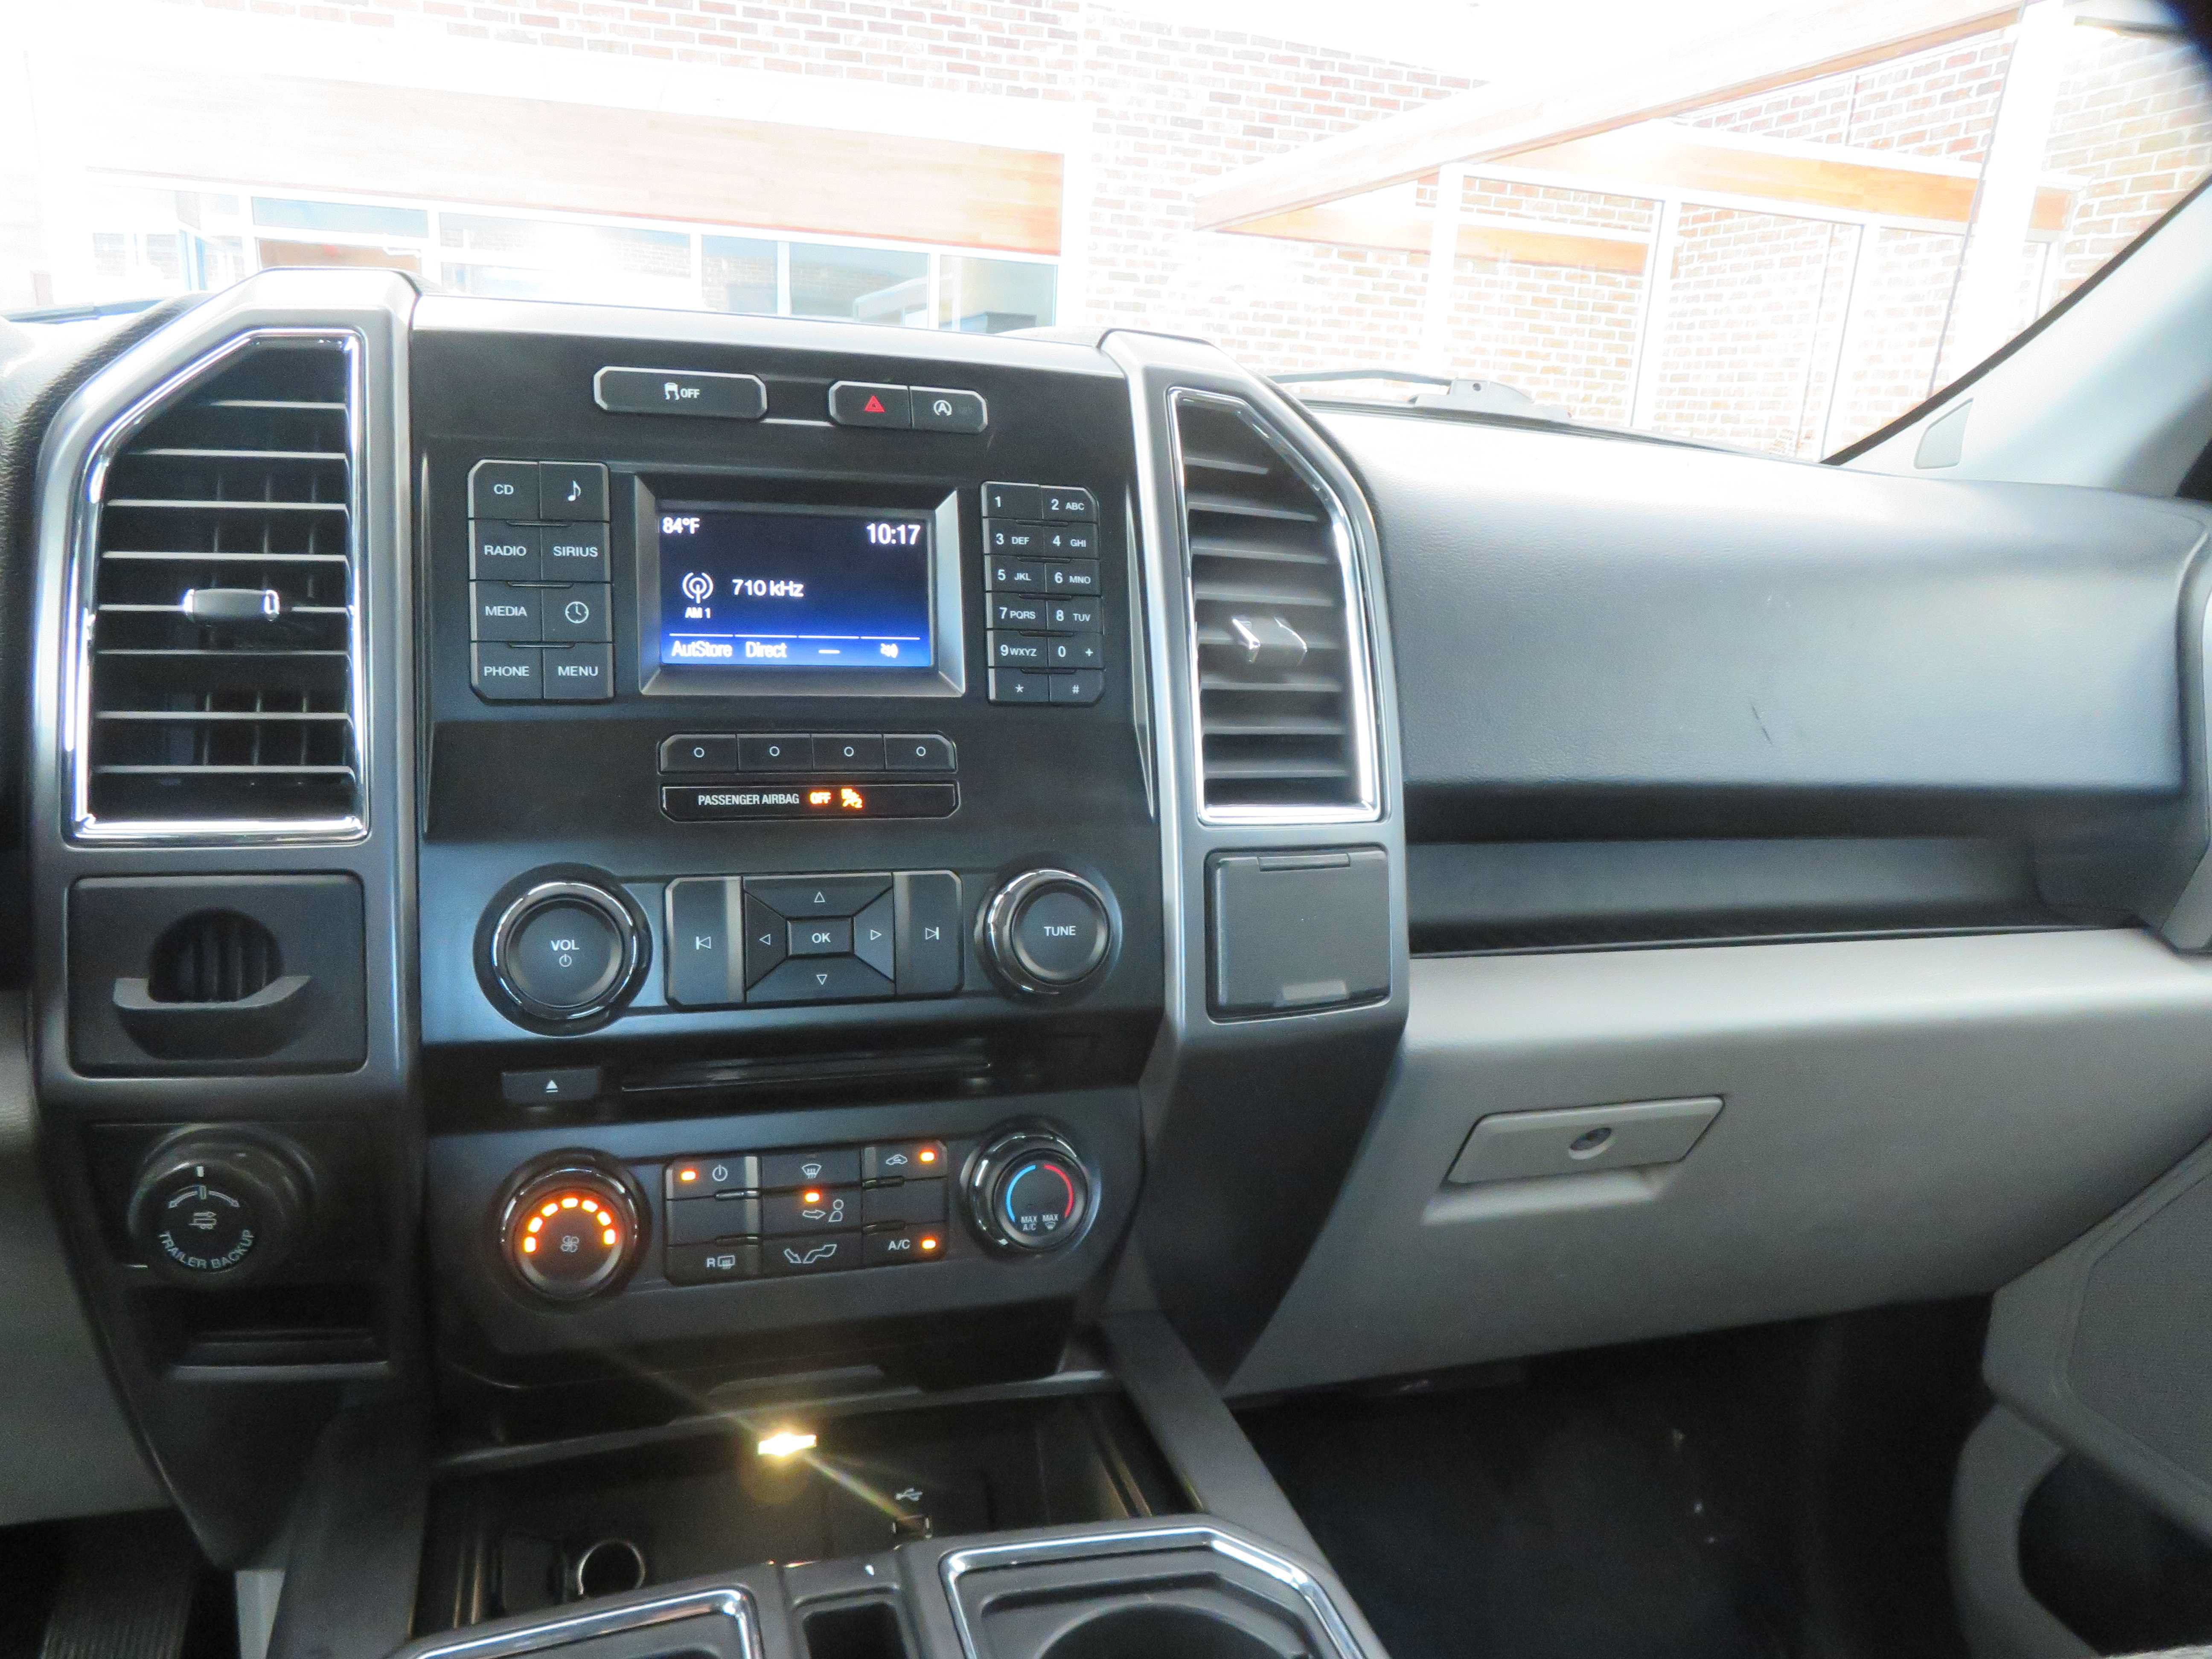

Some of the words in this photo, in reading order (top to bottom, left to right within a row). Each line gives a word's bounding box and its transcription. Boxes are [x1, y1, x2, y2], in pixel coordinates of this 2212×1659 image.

[680, 388, 700, 398] OFF
[494, 484, 514, 495] CD
[995, 496, 1001, 507] 1
[1051, 498, 1059, 510] 2
[1065, 502, 1084, 510] ABC
[867, 523, 921, 545] 10:17
[996, 533, 1004, 545] 3
[1012, 536, 1029, 545] DEF
[1053, 535, 1061, 546] 4
[1070, 539, 1086, 547] GHI
[484, 545, 527, 556] RADIO
[553, 546, 598, 557] SIRIUS
[998, 569, 1006, 581] 5
[1014, 573, 1031, 581] JKL
[1055, 572, 1063, 583] 6
[1069, 576, 1091, 584] MNO
[732, 579, 767, 596] 710
[769, 580, 804, 597] kHz
[485, 606, 527, 616] MEDIA
[685, 607, 702, 618] AM
[704, 608, 710, 618] 1
[1056, 610, 1064, 621] 8
[1073, 613, 1091, 622] TUV
[671, 641, 732, 658] AutStore
[746, 641, 787, 658] Direct
[1058, 646, 1066, 658] 0
[484, 666, 530, 676] PHONE
[558, 666, 598, 676] MENU
[698, 795, 760, 805] PASSENGER
[762, 793, 799, 804] AIRBAG
[810, 792, 831, 804] OFF
[1044, 926, 1076, 936] TUNE
[812, 932, 831, 943] OK
[551, 940, 579, 951] VOL
[160, 1231, 207, 1268] TRAILER
[211, 1229, 254, 1268] BACKUP
[888, 1239, 910, 1250] A/C
